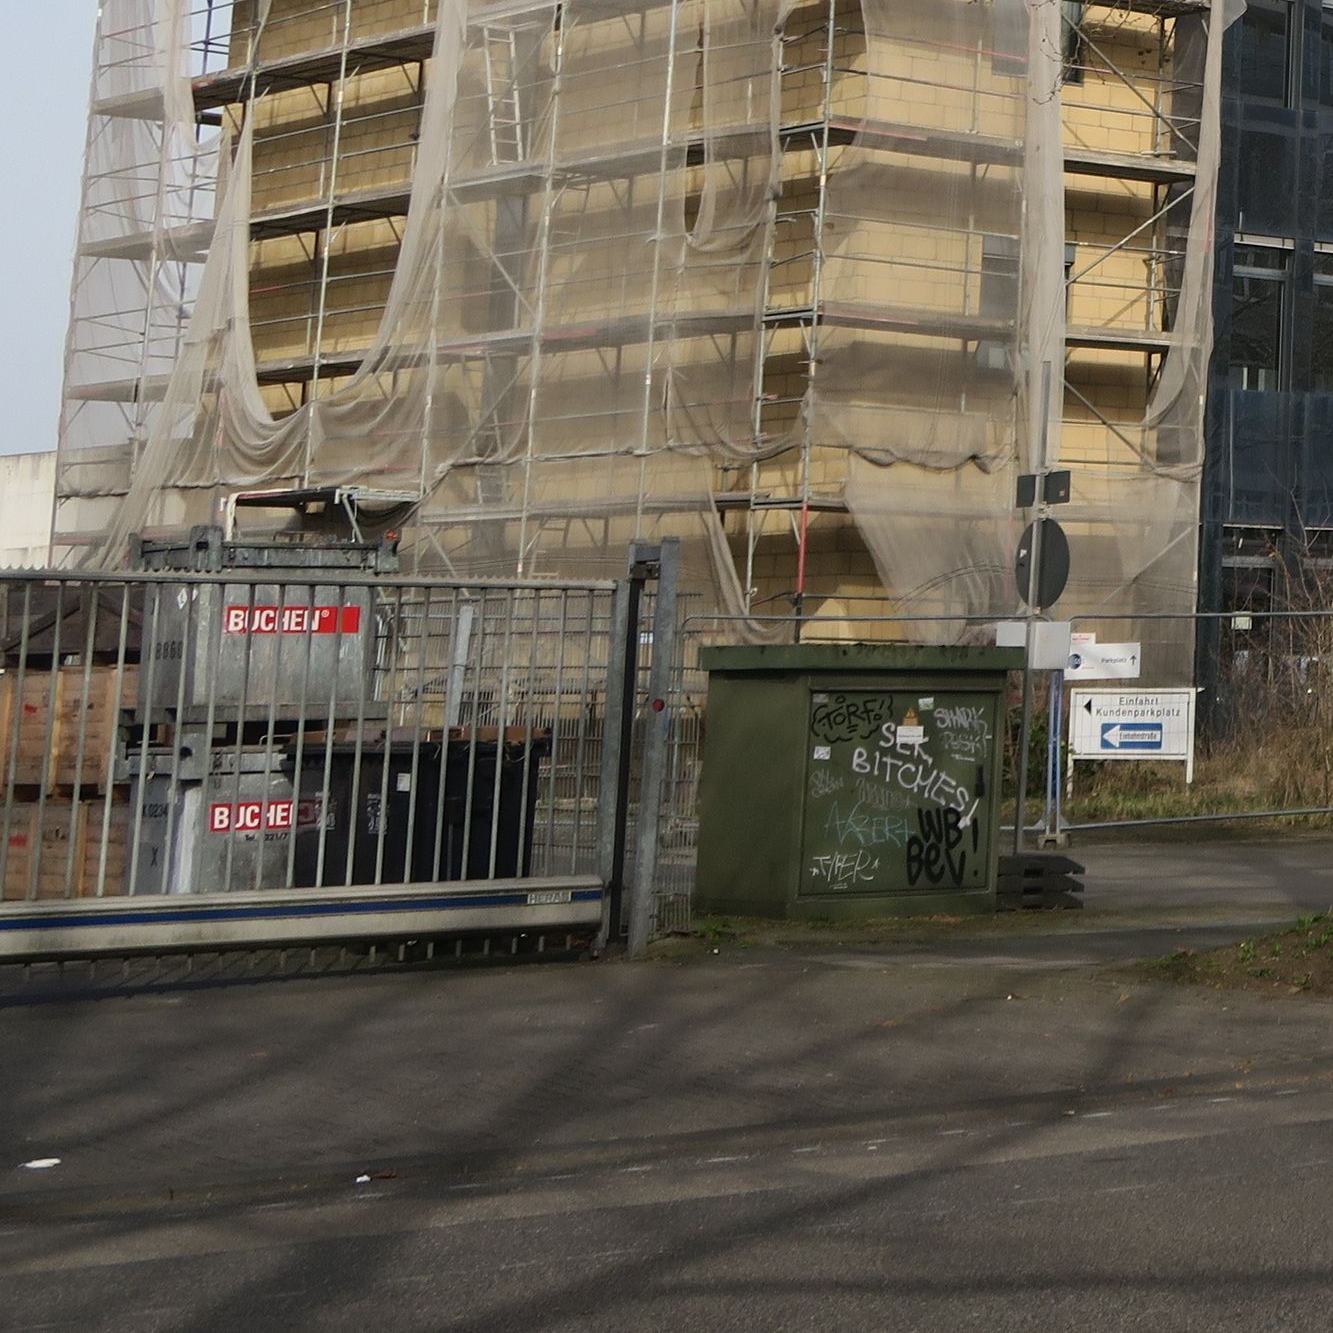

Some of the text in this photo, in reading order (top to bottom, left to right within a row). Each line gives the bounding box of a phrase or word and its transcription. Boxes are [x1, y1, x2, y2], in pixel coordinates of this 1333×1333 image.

[1119, 697, 1159, 706] Einfahrt
[1096, 708, 1181, 719] Kundenparkplatz
[1119, 732, 1157, 740] Einbahnstraße
